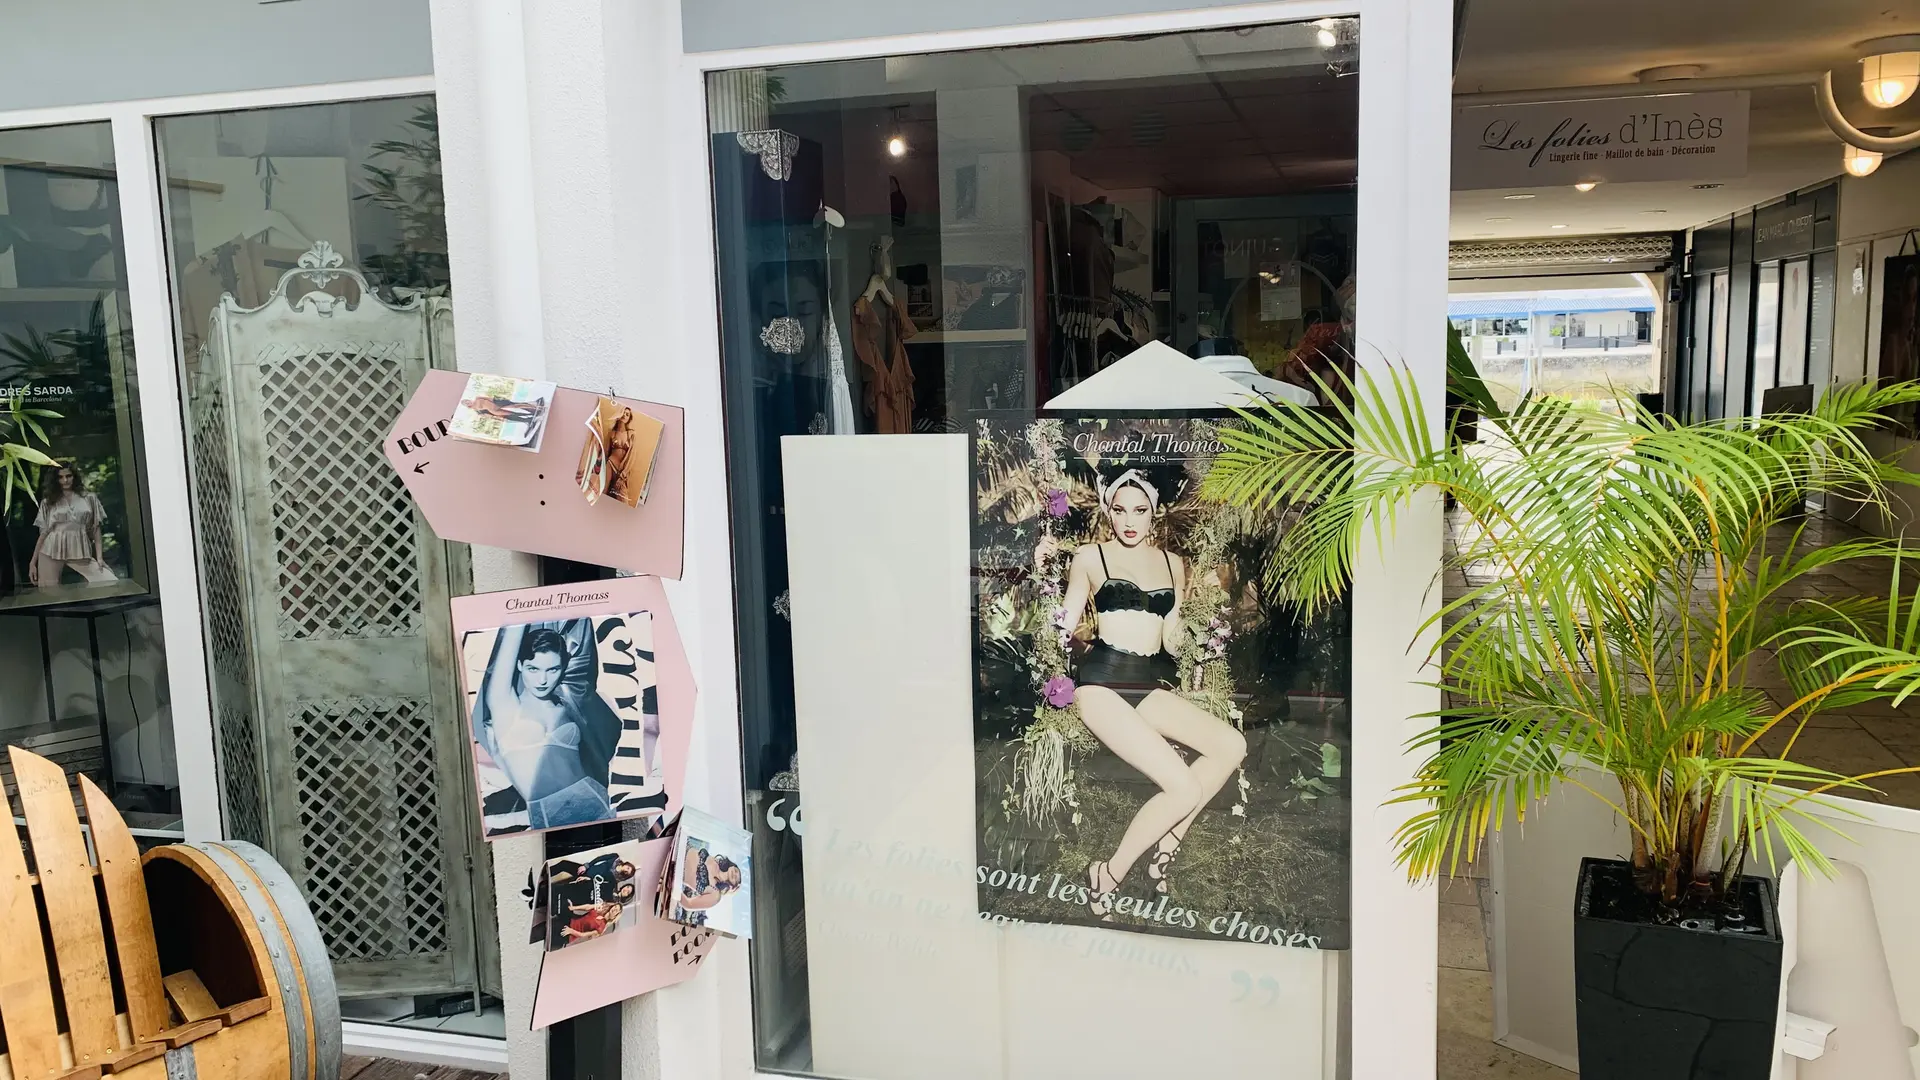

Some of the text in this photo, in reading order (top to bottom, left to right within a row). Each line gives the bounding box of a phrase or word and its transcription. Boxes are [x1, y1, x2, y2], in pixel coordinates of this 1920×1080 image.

[1478, 112, 1723, 168] Les folies d'Inès
[1549, 144, 1716, 164] Lingerie fine Maillot de bain Décoration
[33, 386, 74, 396] SARDA
[1073, 433, 1146, 453] Chantal
[1140, 455, 1166, 463] PARIS
[505, 591, 610, 610] Chantal Thomass
[976, 865, 1041, 894] sont
[1048, 873, 1092, 905] les
[1099, 892, 1199, 929] seules
[1209, 911, 1322, 950] choses
